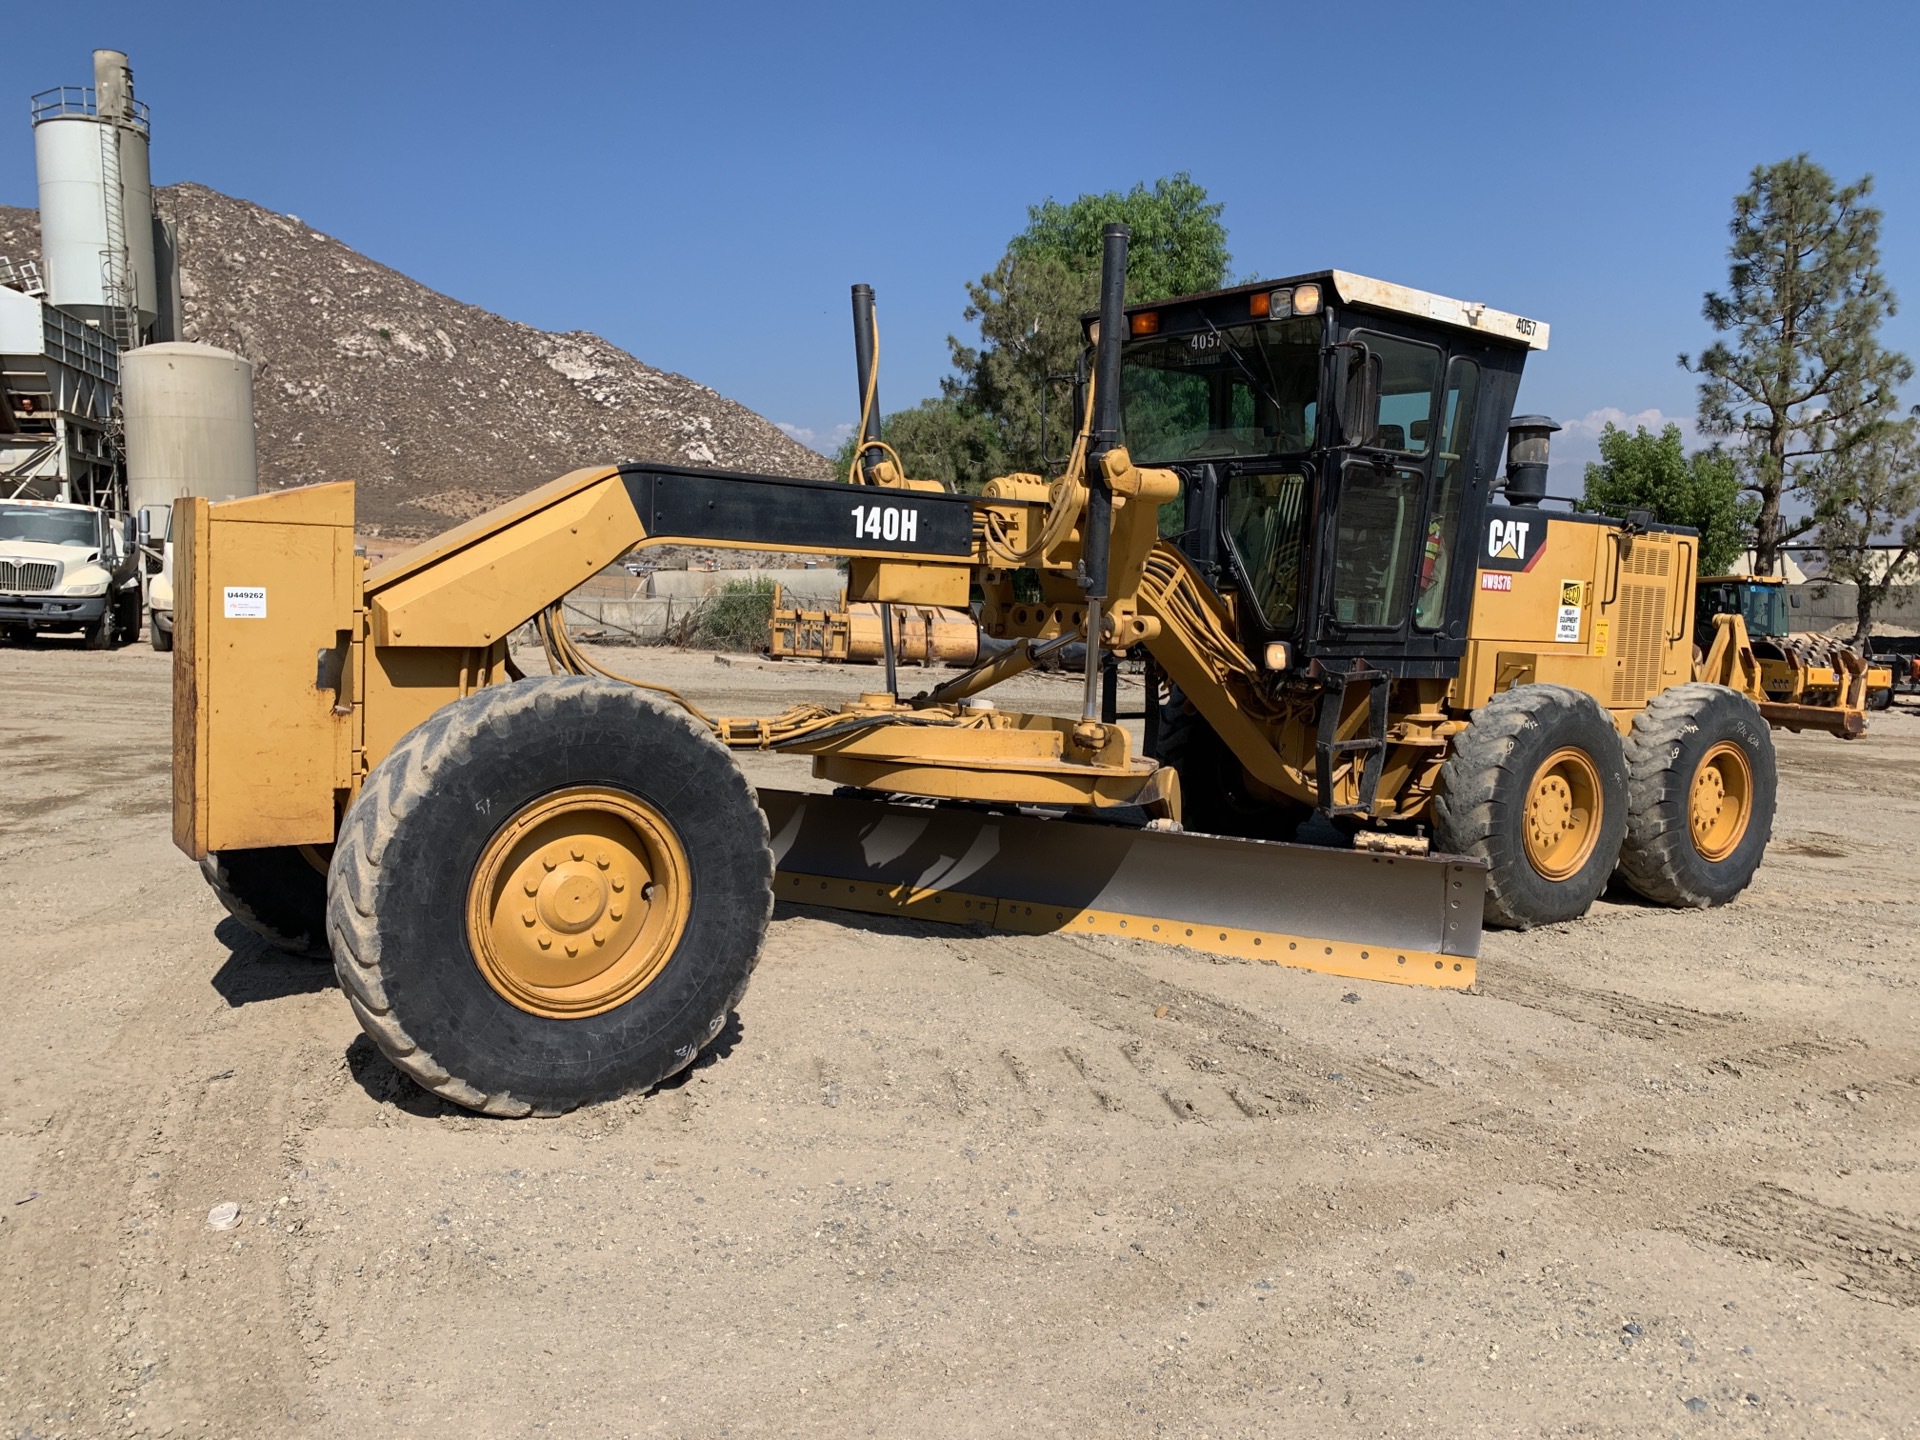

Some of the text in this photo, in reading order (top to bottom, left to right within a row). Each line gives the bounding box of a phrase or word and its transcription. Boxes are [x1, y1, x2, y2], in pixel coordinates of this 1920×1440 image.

[1516, 317, 1537, 336] 4057
[1191, 331, 1222, 350] 4057
[851, 505, 918, 542] 140H
[1488, 519, 1530, 559] CAT
[1560, 616, 1578, 624] EQUIPMENT
[1561, 624, 1575, 632] RENTALS
